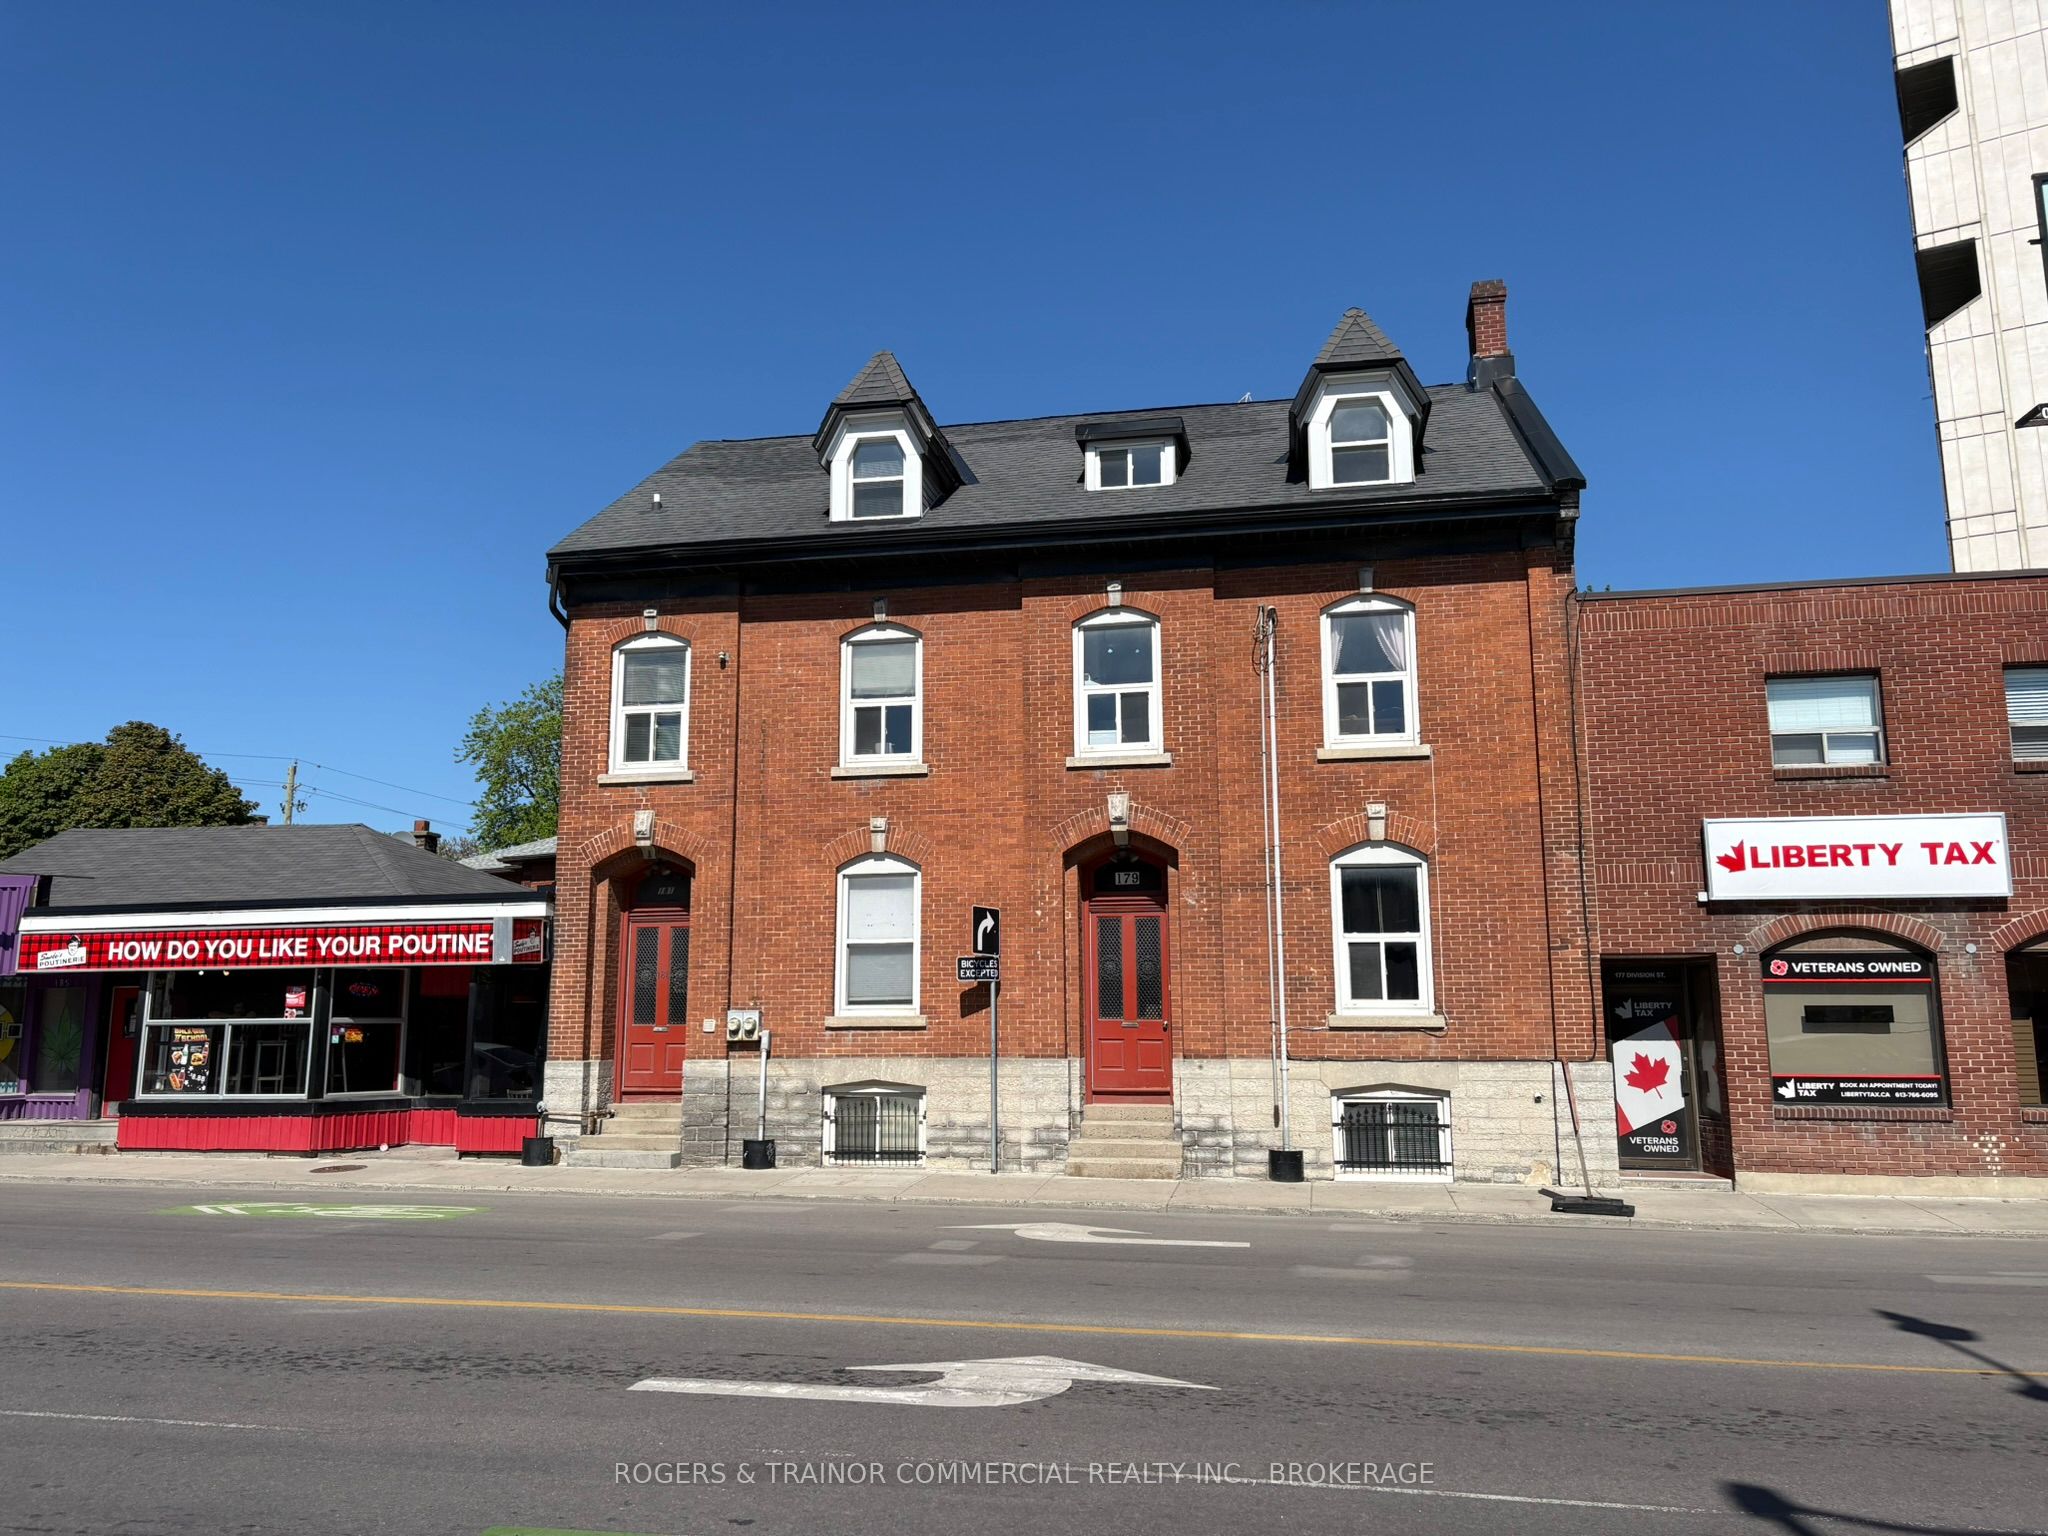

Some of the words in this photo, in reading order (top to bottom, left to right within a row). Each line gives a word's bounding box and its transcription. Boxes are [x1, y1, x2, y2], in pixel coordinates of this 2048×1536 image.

[1750, 843, 1903, 868] LIBERTY
[1920, 841, 1997, 865] TAX
[1116, 872, 1140, 884] 179
[108, 941, 163, 961] HOW
[167, 939, 200, 960] DO
[205, 938, 253, 959] YOU
[259, 937, 309, 957] LIKE
[316, 935, 380, 956] YOUR
[388, 933, 494, 955] POUTINE
[40, 956, 84, 966] POUTINERIE
[961, 959, 998, 968] BICYCLES
[1791, 962, 1865, 973] VETERANS
[1867, 962, 1921, 973] OWNED
[960, 968, 998, 978] EXCEPTED
[1634, 1001, 1673, 1009] LIBERTY
[1634, 1009, 1654, 1017] TAX
[1796, 1082, 1835, 1090] LIBERTY
[1797, 1089, 1817, 1097] TAX
[1629, 1136, 1679, 1145] VETERANS
[1643, 1144, 1680, 1153] OWNED
